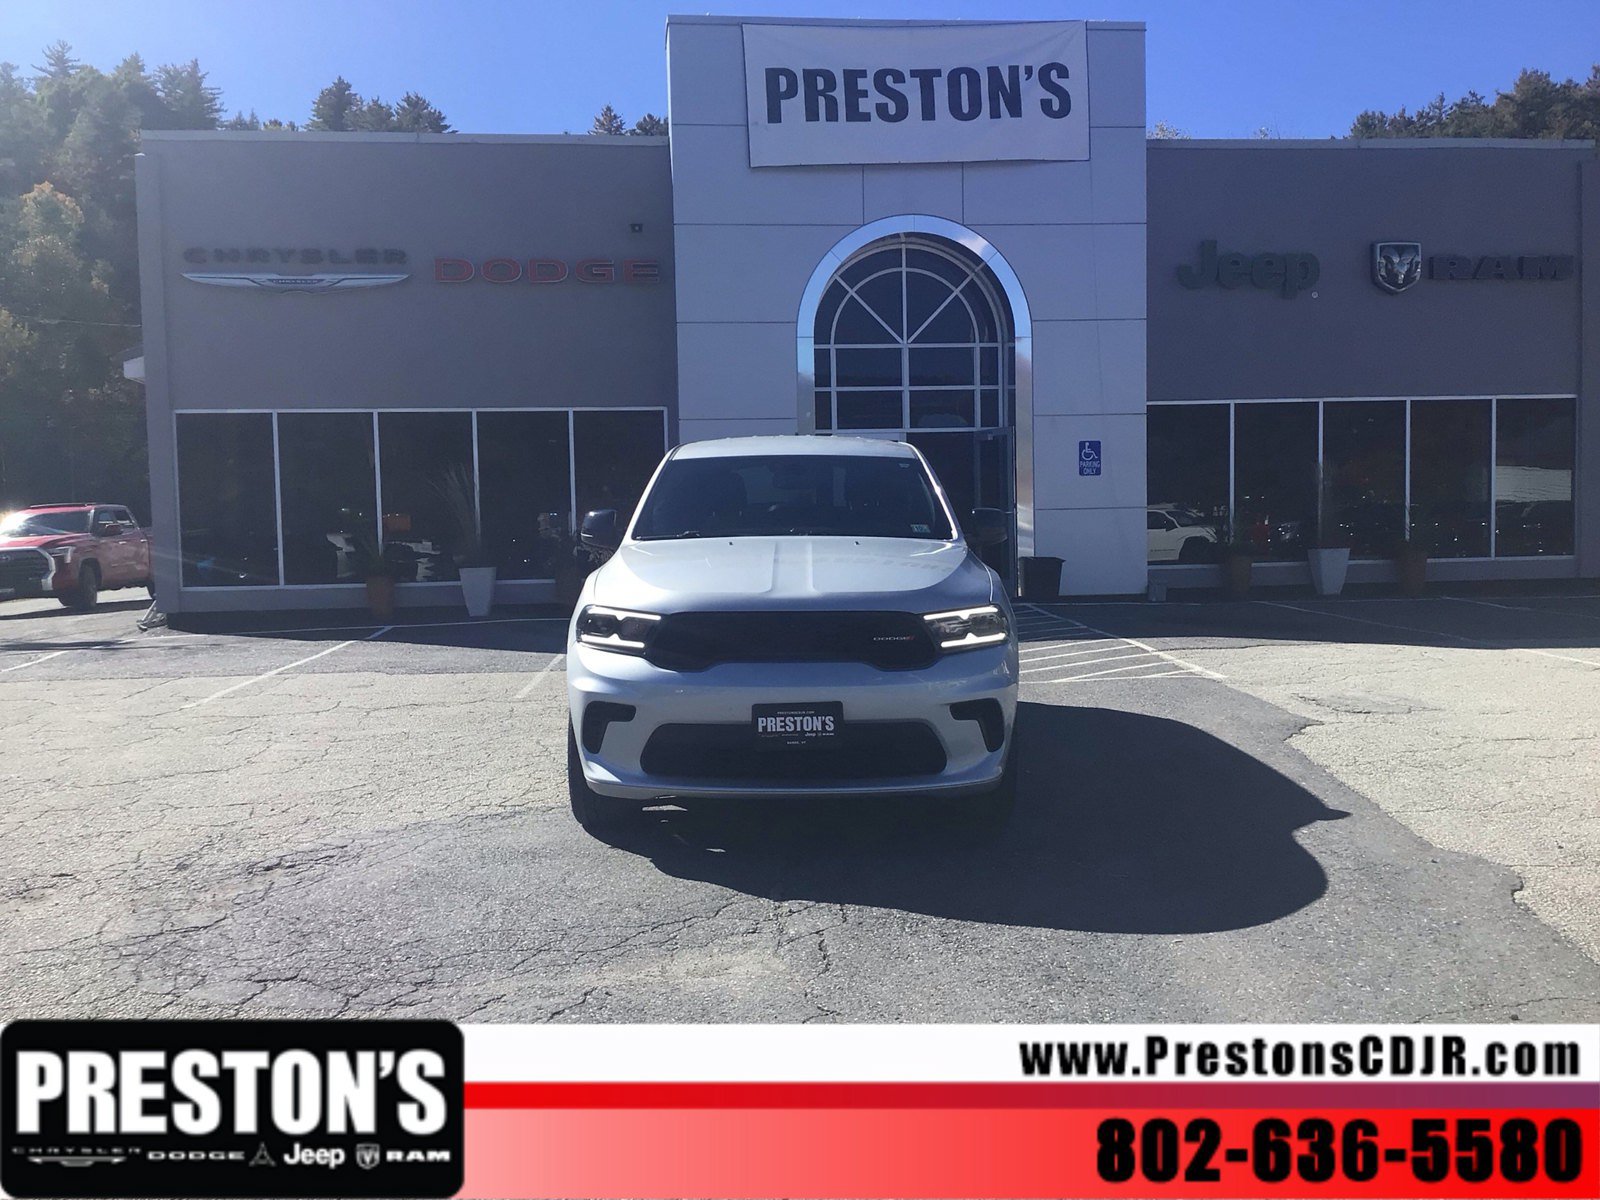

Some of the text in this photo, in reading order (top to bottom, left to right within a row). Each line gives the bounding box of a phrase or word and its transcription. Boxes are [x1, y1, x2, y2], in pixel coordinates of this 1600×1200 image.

[764, 61, 1072, 124] PRESTON'S
[182, 247, 408, 267] CHRYSLER
[1428, 254, 1575, 281] RAM
[434, 257, 661, 285] DODGE
[1177, 240, 1321, 299] Jeep
[1079, 460, 1101, 468] PARKING
[1083, 467, 1097, 475] ONLY
[757, 715, 835, 733] PRESTON'S
